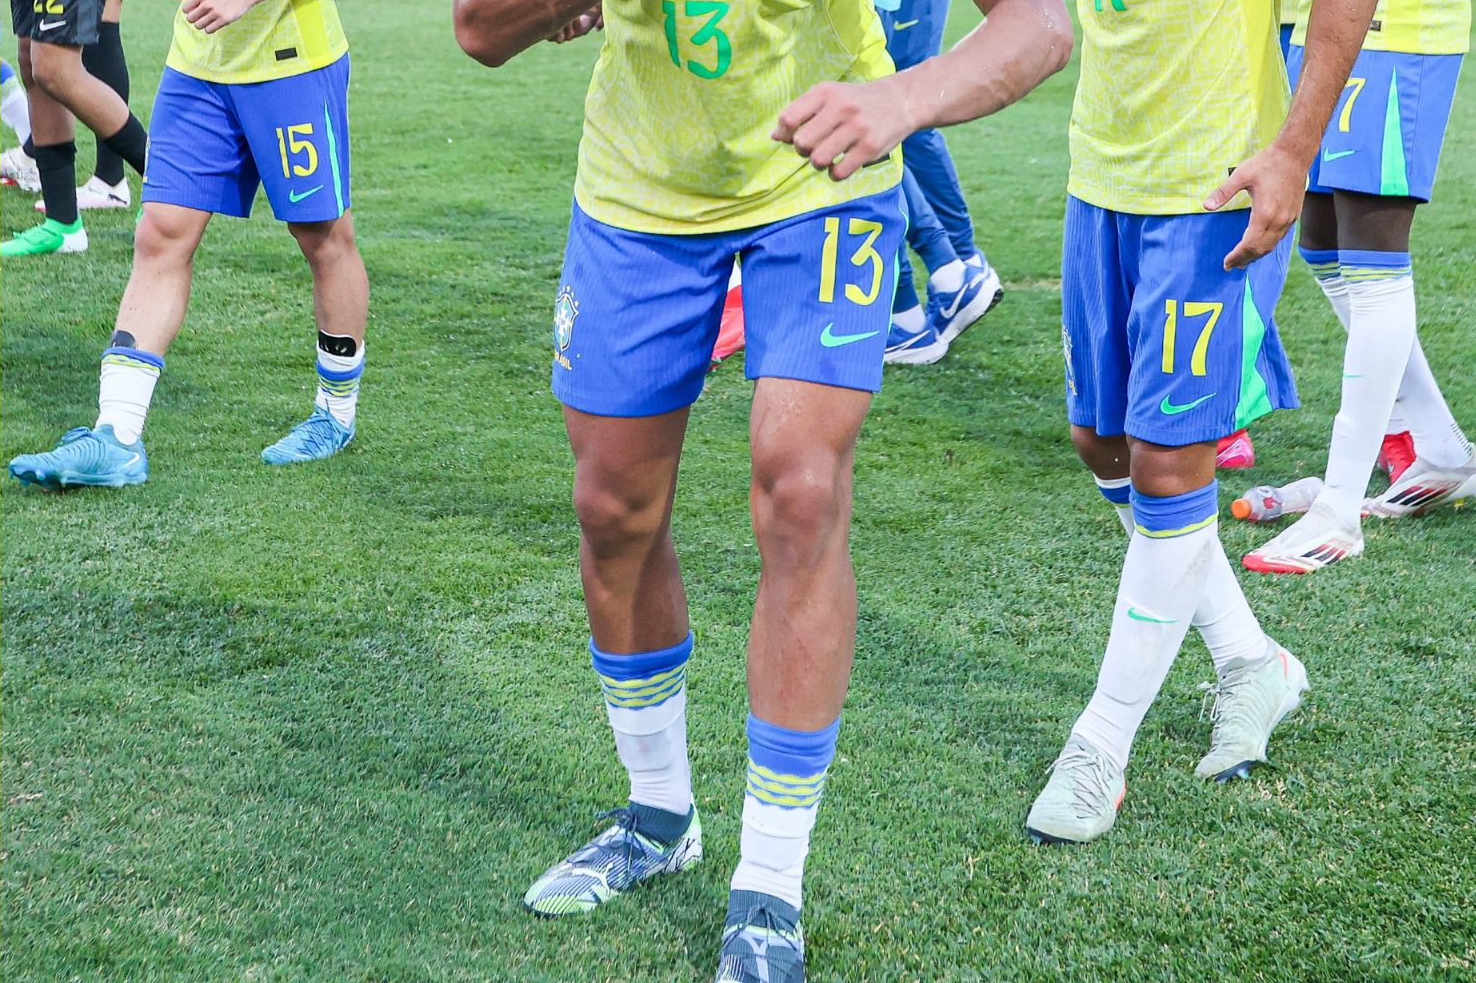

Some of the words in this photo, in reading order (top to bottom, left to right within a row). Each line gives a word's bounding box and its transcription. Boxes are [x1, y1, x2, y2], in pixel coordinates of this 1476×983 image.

[662, 0, 732, 80] 13
[276, 122, 320, 179] 15
[818, 216, 885, 306] 13
[1161, 298, 1224, 377] 17
